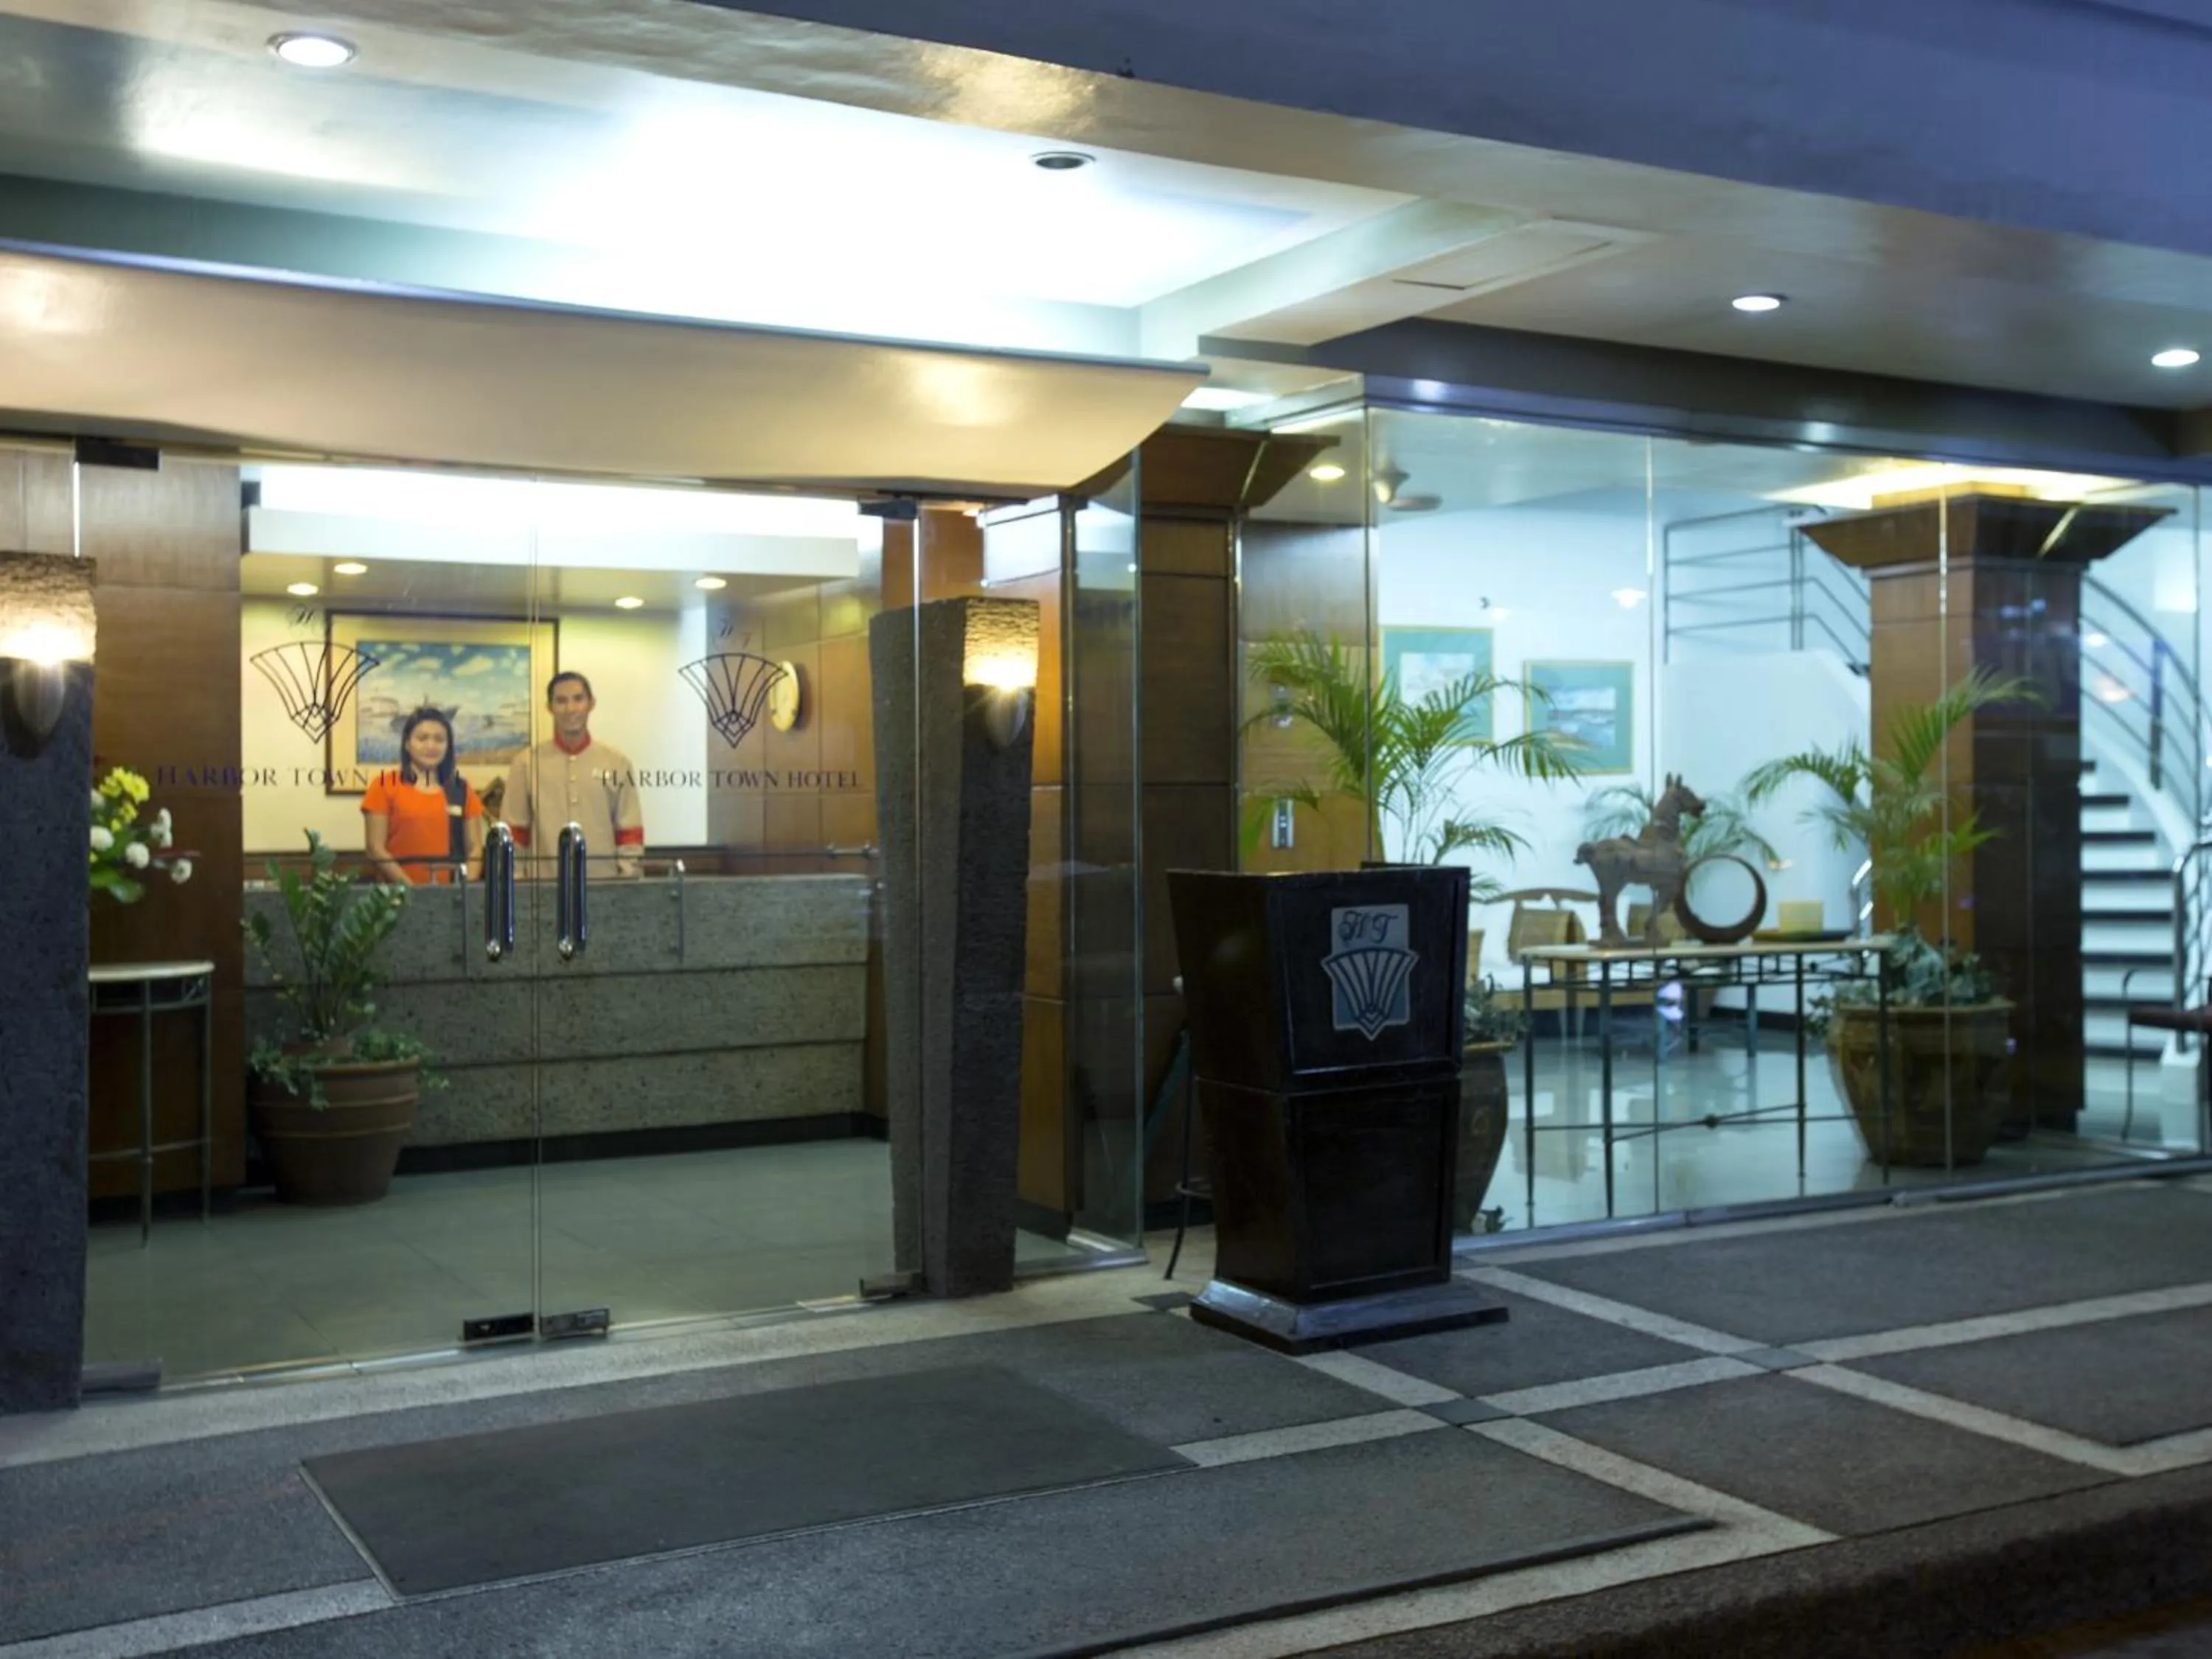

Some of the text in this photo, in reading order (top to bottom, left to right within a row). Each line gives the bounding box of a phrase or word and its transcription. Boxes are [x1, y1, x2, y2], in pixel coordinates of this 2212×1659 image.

[155, 765, 278, 787] HARBOR
[290, 766, 369, 787] TOWN
[601, 769, 863, 788] HARBOR TOWN HOTEL
